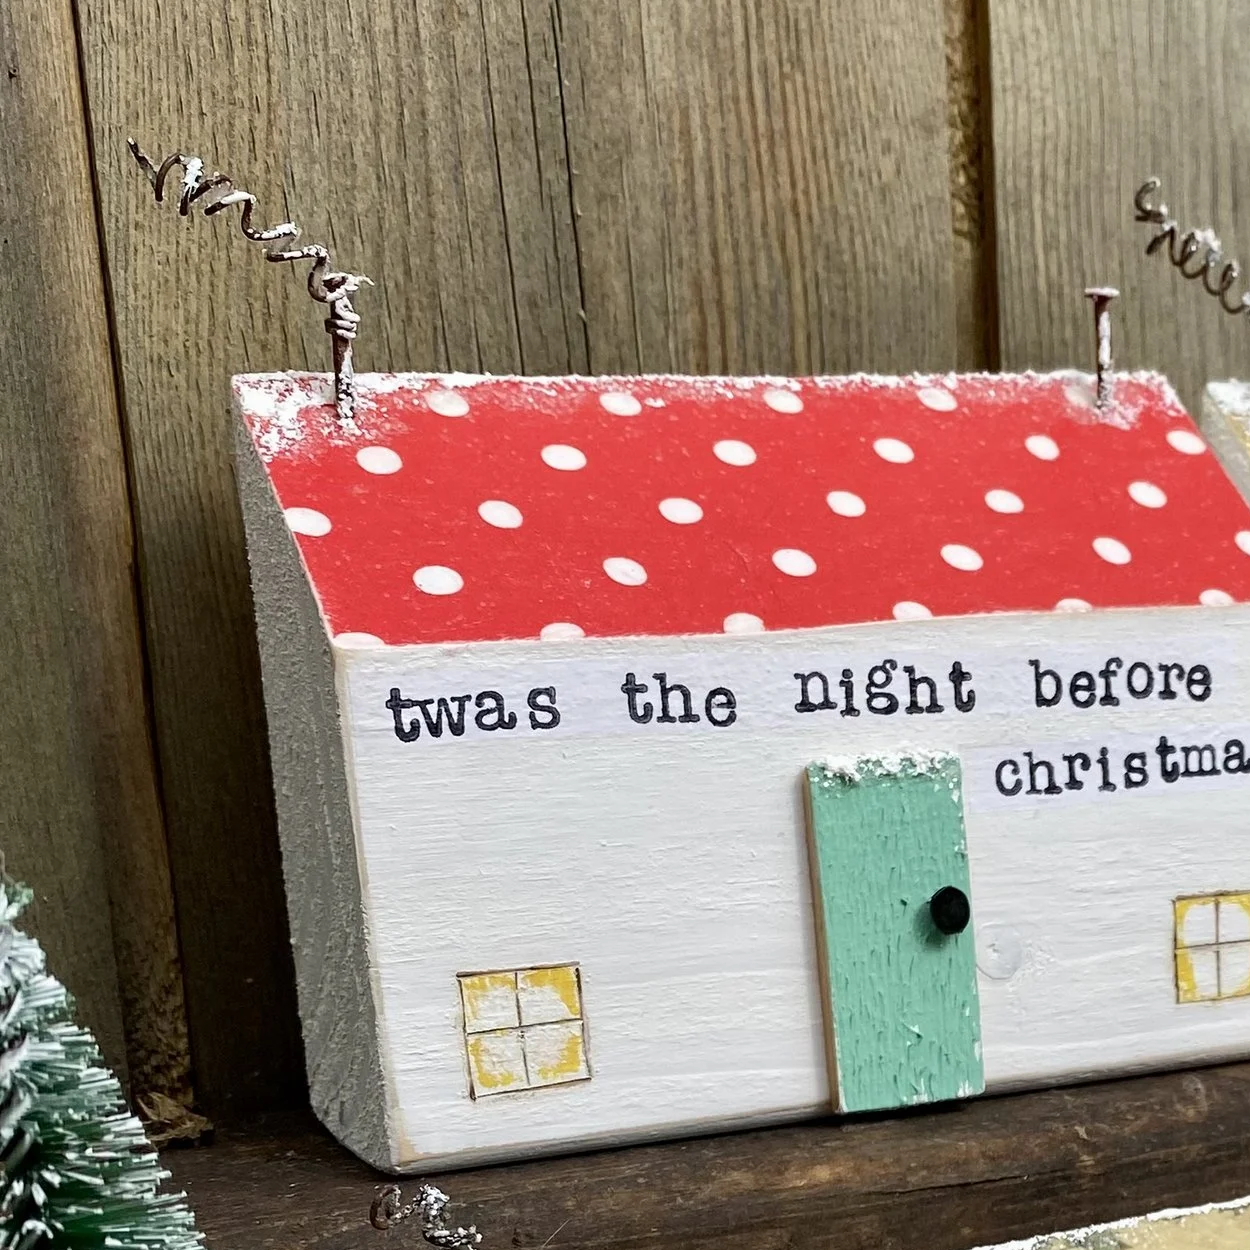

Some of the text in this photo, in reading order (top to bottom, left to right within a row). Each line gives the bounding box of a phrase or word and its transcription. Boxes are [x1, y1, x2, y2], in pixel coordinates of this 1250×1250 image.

[385, 656, 1212, 744] twas the night before
